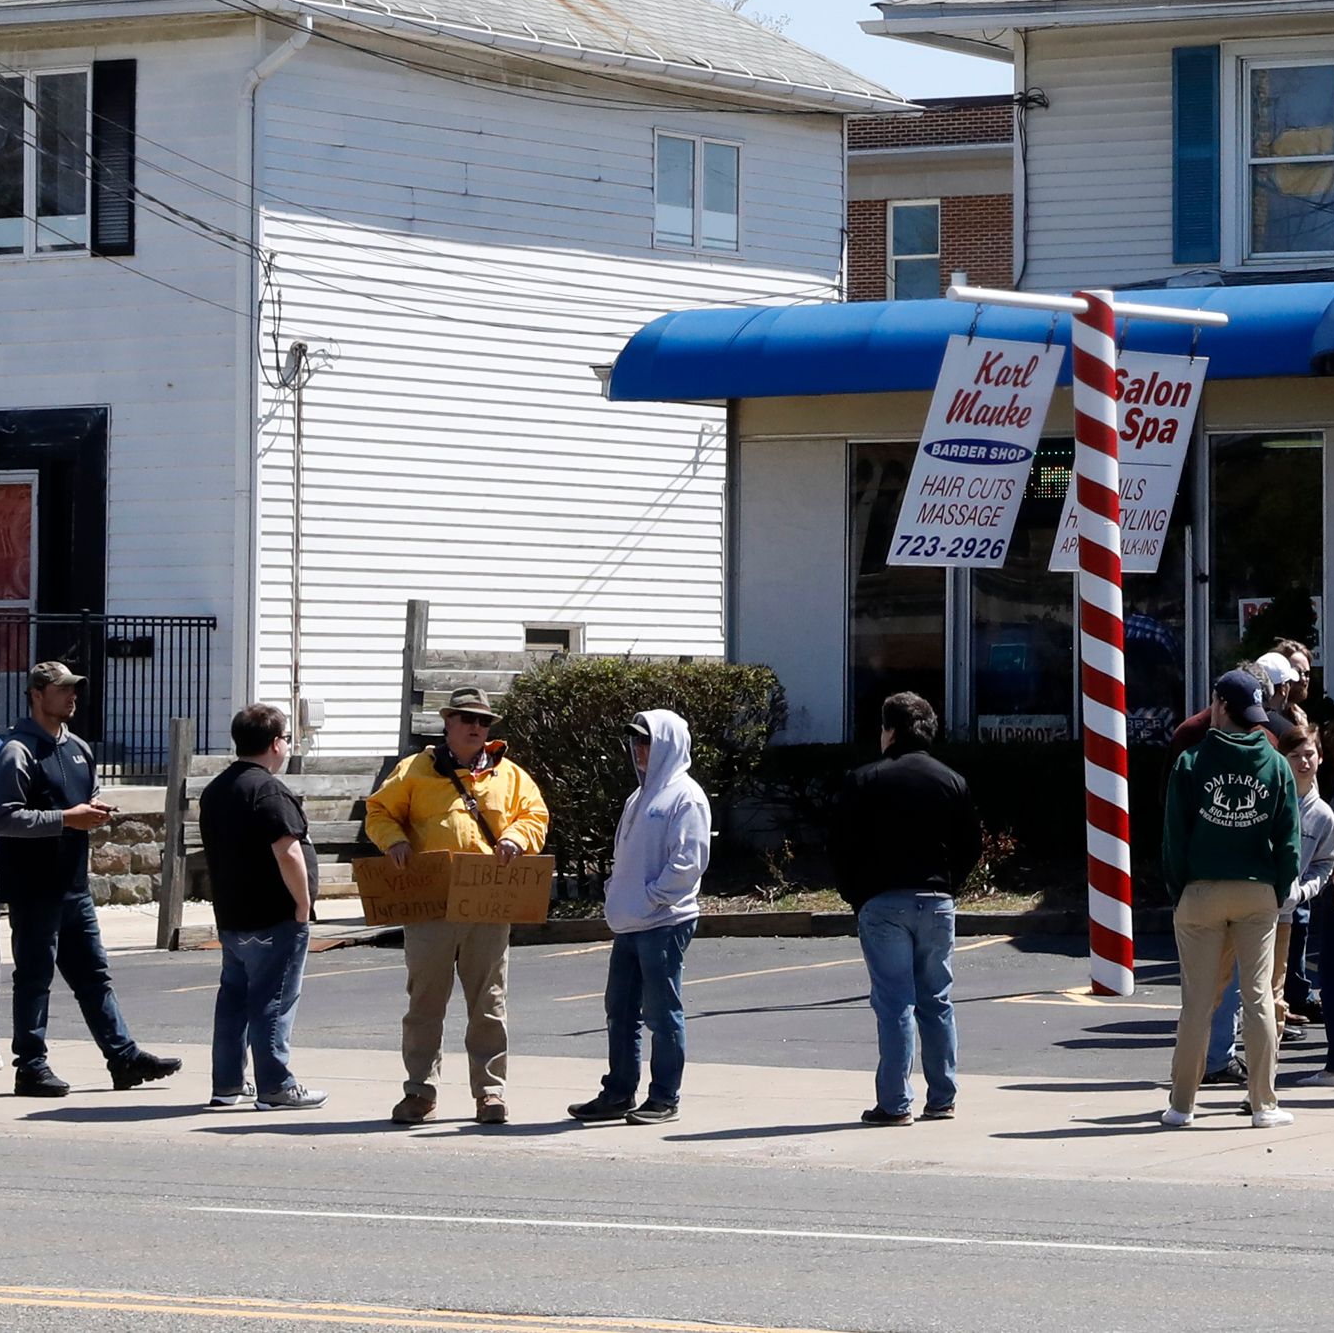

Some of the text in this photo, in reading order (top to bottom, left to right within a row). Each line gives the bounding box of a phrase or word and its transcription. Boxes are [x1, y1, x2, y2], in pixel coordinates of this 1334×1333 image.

[974, 350, 1040, 389] Karl
[1115, 368, 1193, 408] Salon
[945, 388, 1033, 429] Manke
[1119, 407, 1179, 450] Spa
[930, 442, 1027, 462] BARBER SHOP
[919, 474, 965, 497] HAIR
[967, 477, 1016, 501] CUTS
[916, 502, 1005, 527] MASSAGE
[895, 535, 1006, 560] 723-2926
[1120, 538, 1160, 556] ALK-INS
[1203, 773, 1270, 799] DM FARMS
[1198, 807, 1269, 828] WHOLESALE DEER FEED
[1208, 806, 1258, 821] 810-441-9485
[455, 857, 547, 888] LIBERTY
[361, 896, 448, 923] Tyranny
[458, 898, 512, 920] CURE
